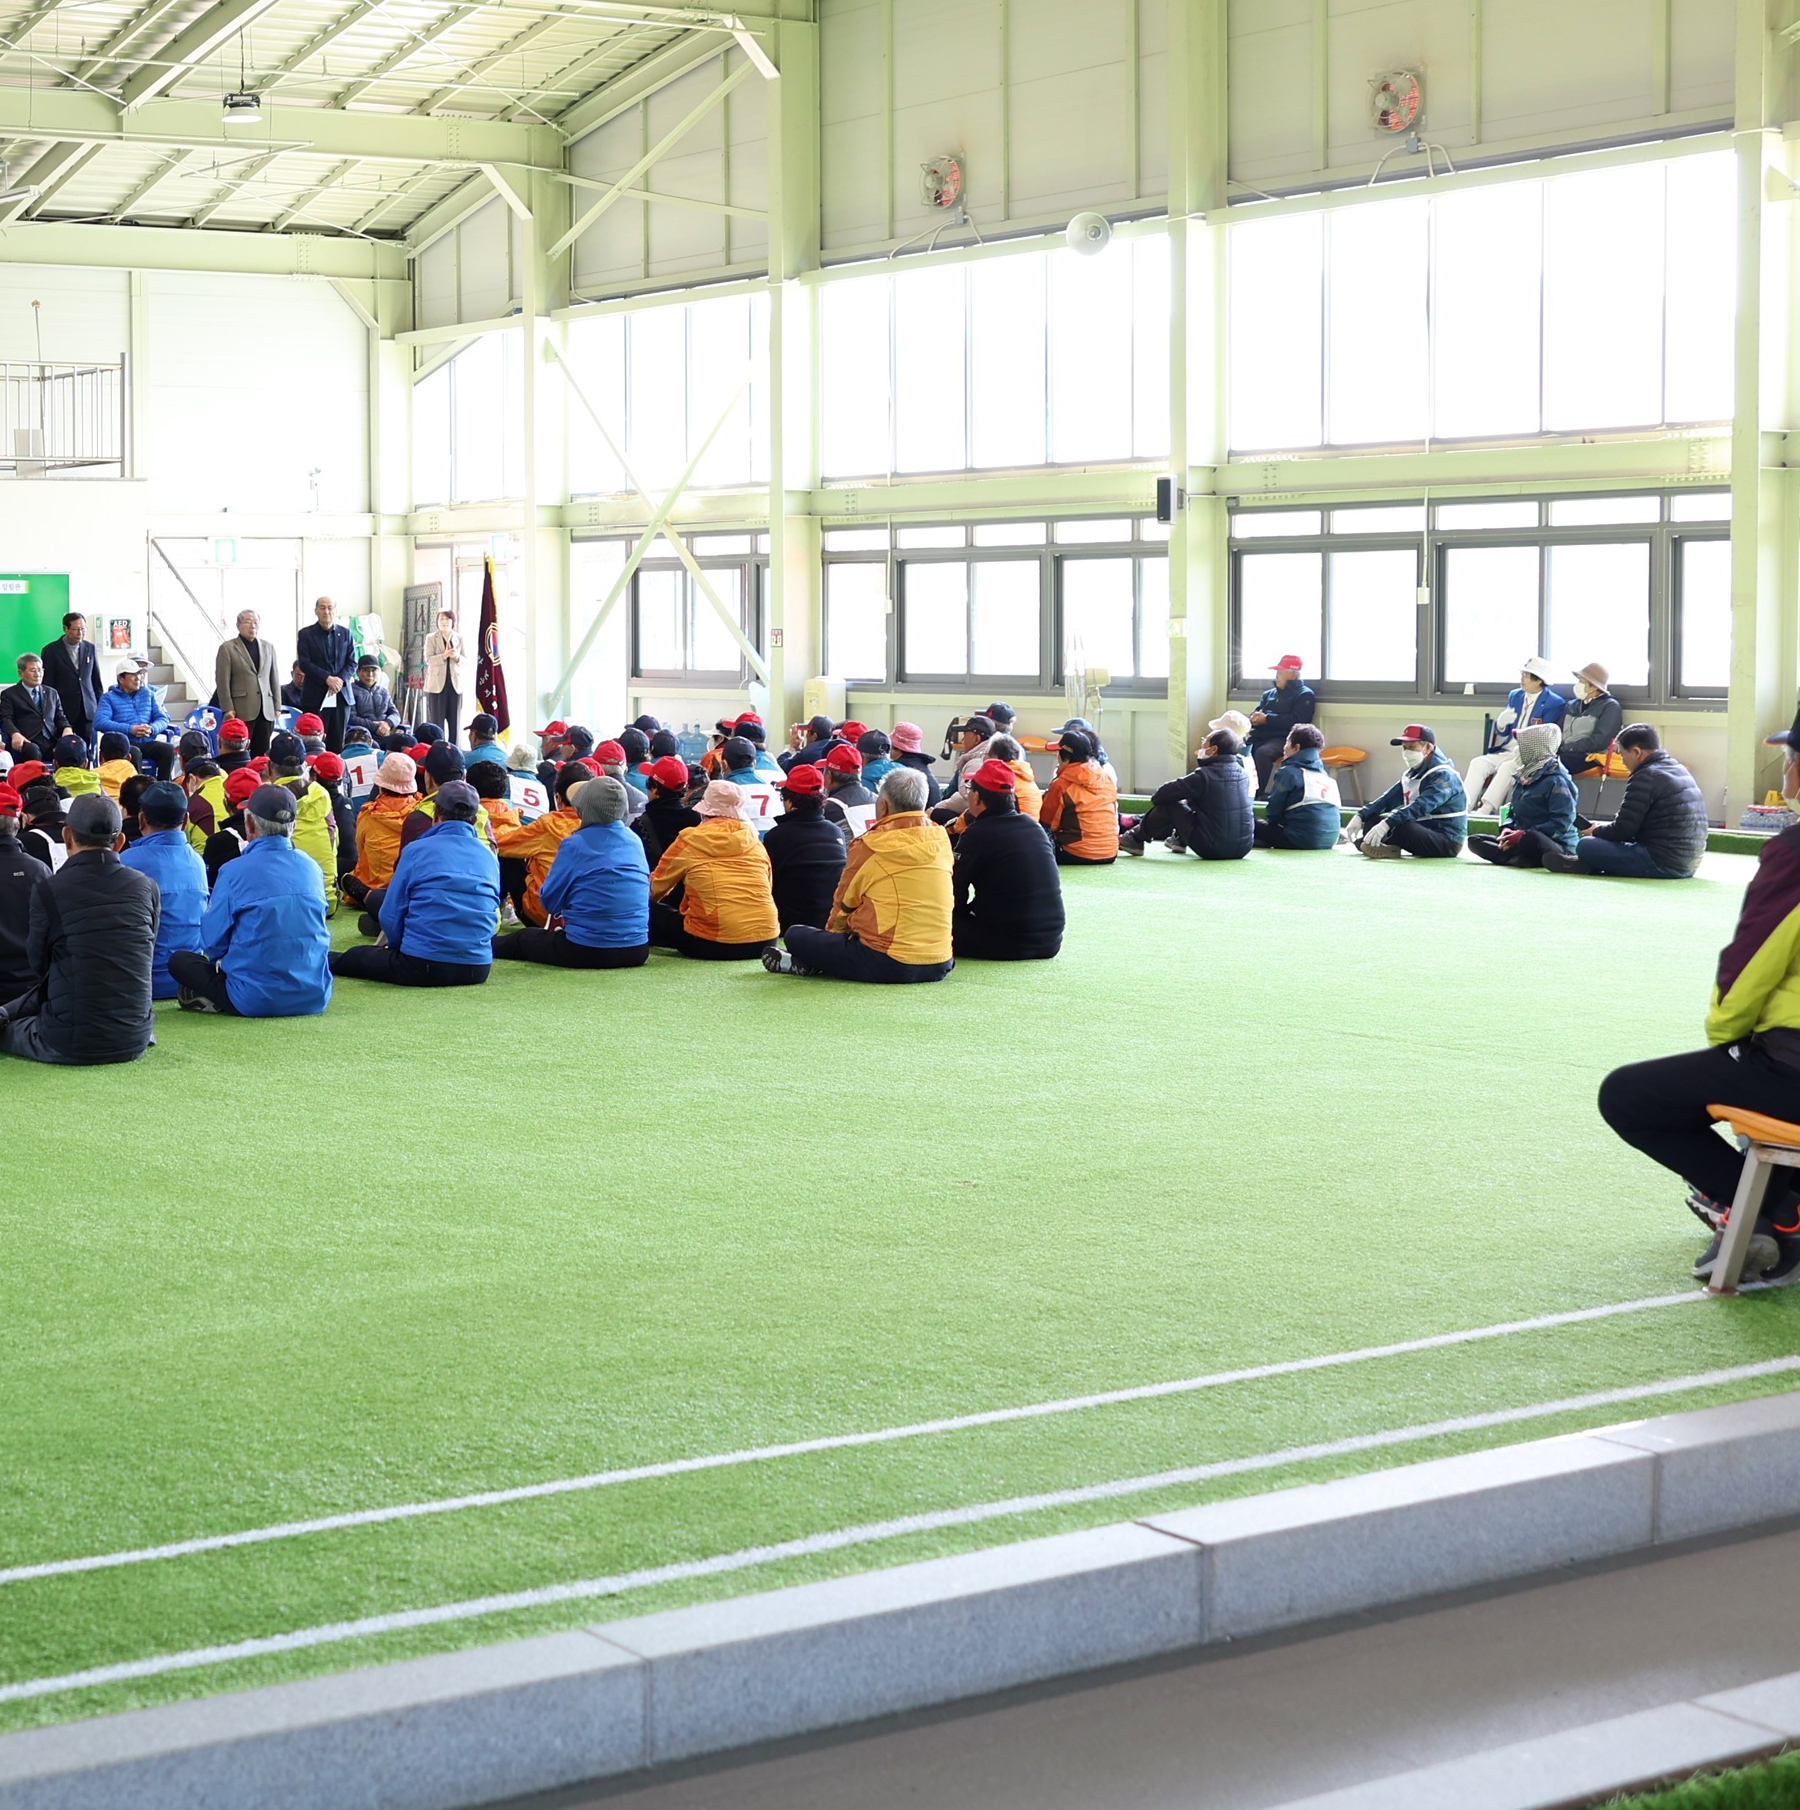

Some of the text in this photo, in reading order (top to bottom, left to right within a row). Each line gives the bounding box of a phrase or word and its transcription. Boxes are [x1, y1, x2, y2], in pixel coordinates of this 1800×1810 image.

[350, 766, 364, 785] 1
[523, 787, 541, 807] 5
[751, 795, 770, 816] 7
